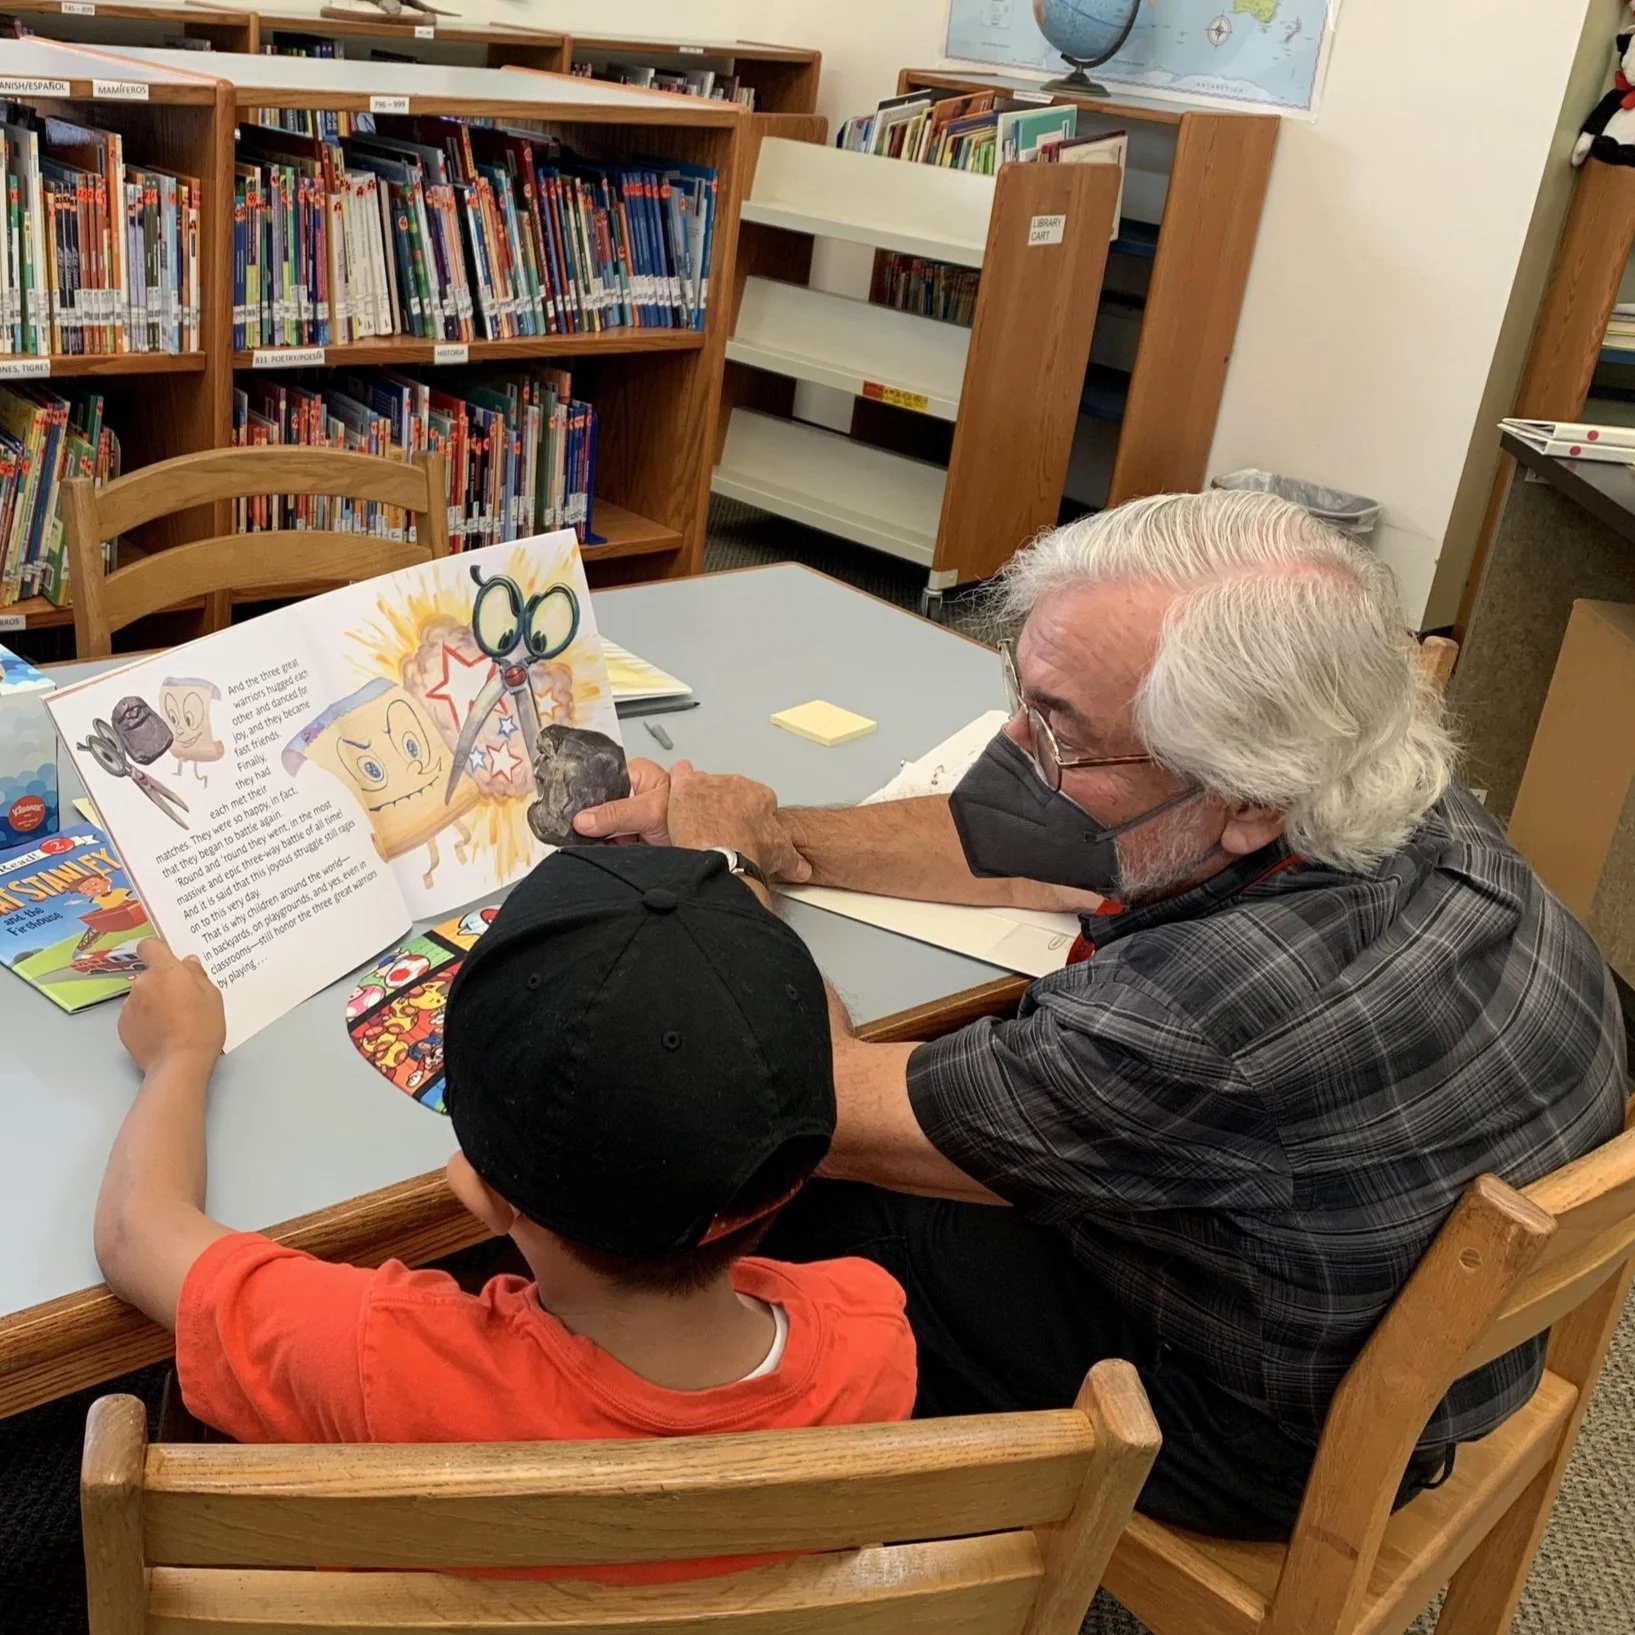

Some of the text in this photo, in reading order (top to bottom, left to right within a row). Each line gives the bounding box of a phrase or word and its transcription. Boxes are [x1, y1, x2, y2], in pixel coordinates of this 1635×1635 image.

[98, 84, 147, 95] MAMÍFEROS
[1030, 230, 1051, 241] CART
[1032, 217, 1062, 229] LIBRARY
[22, 363, 49, 373] TIGRES
[227, 658, 299, 696] And the three great
[266, 675, 294, 693] hugged
[294, 669, 310, 682] each
[232, 685, 308, 726] other and danced for
[232, 700, 311, 744] joy, and they became
[234, 730, 282, 757] fast friends.
[235, 766, 271, 790] they had
[236, 753, 268, 772] Finally,
[210, 784, 267, 819] each met their
[155, 786, 299, 864] matches. They were so happy, in fact,
[204, 857, 221, 873] and
[248, 835, 267, 852] they
[267, 823, 291, 840] went,
[289, 817, 299, 828] in
[298, 810, 313, 823] the
[313, 800, 332, 816] most
[50, 842, 65, 850] 2
[162, 810, 284, 879] that they began to battle again.
[176, 808, 344, 906] massive and epic three-way battle of all time!
[7, 848, 122, 903] STANLEY
[183, 819, 356, 920] And it is said that this joyous struggle still rages
[3, 907, 45, 927] and the
[6, 911, 64, 937] Firehouse
[190, 888, 261, 934] on to this very day.
[201, 928, 222, 944] That
[222, 923, 230, 933] is
[230, 912, 246, 928] why
[247, 894, 279, 918] children
[279, 880, 308, 900] around
[307, 870, 322, 884] the
[203, 859, 367, 962] in backyards, on playgrounds, and yes, even in
[273, 917, 297, 937] honor
[297, 908, 312, 923] the
[312, 897, 333, 914] three
[333, 885, 353, 904] great
[216, 960, 257, 990] by playing
